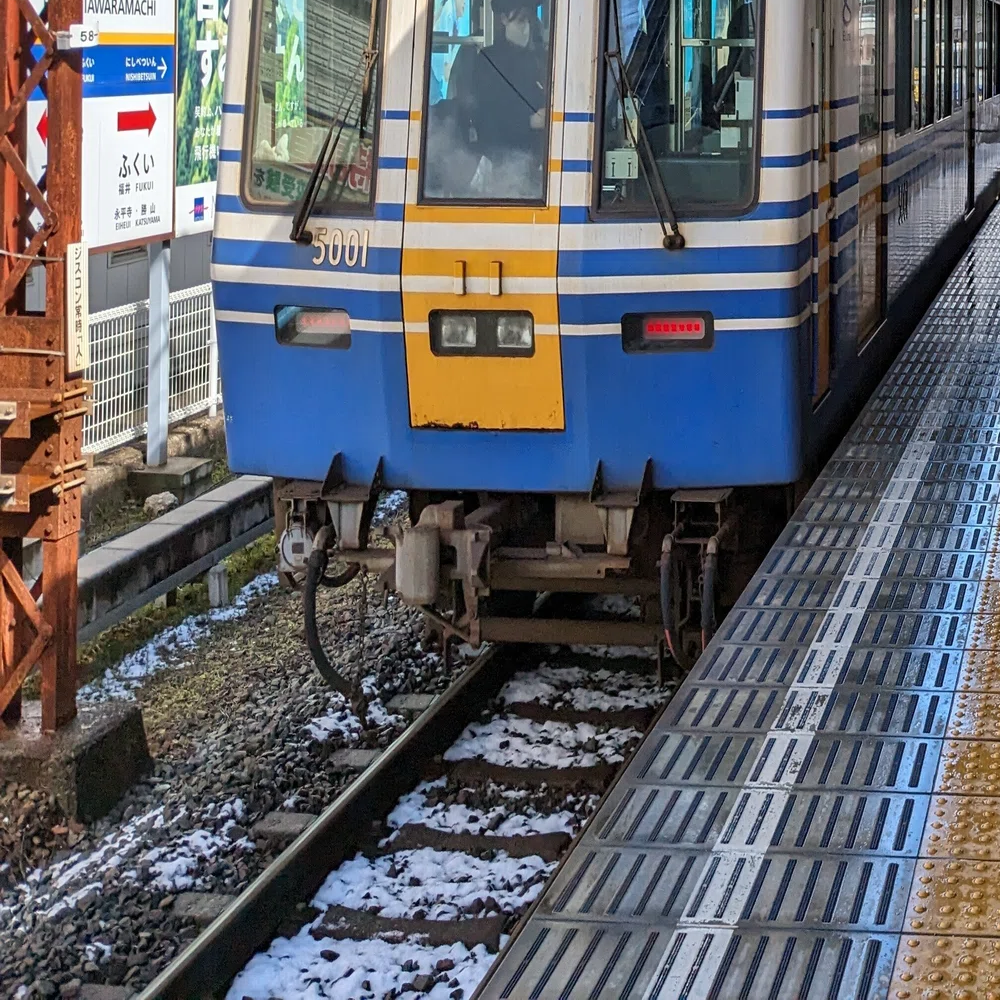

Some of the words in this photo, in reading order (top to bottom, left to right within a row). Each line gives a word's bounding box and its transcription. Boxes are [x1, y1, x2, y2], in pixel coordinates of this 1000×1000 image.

[125, 56, 156, 68] にしべついん
[82, 74, 95, 82] UKUI
[125, 73, 156, 82] NISHIBETSUIN
[118, 152, 155, 178] ふくい
[119, 182, 131, 196] 福井
[135, 181, 154, 192] FUKUI
[135, 215, 161, 227] KATSUYAMA
[312, 227, 370, 268] 5001
